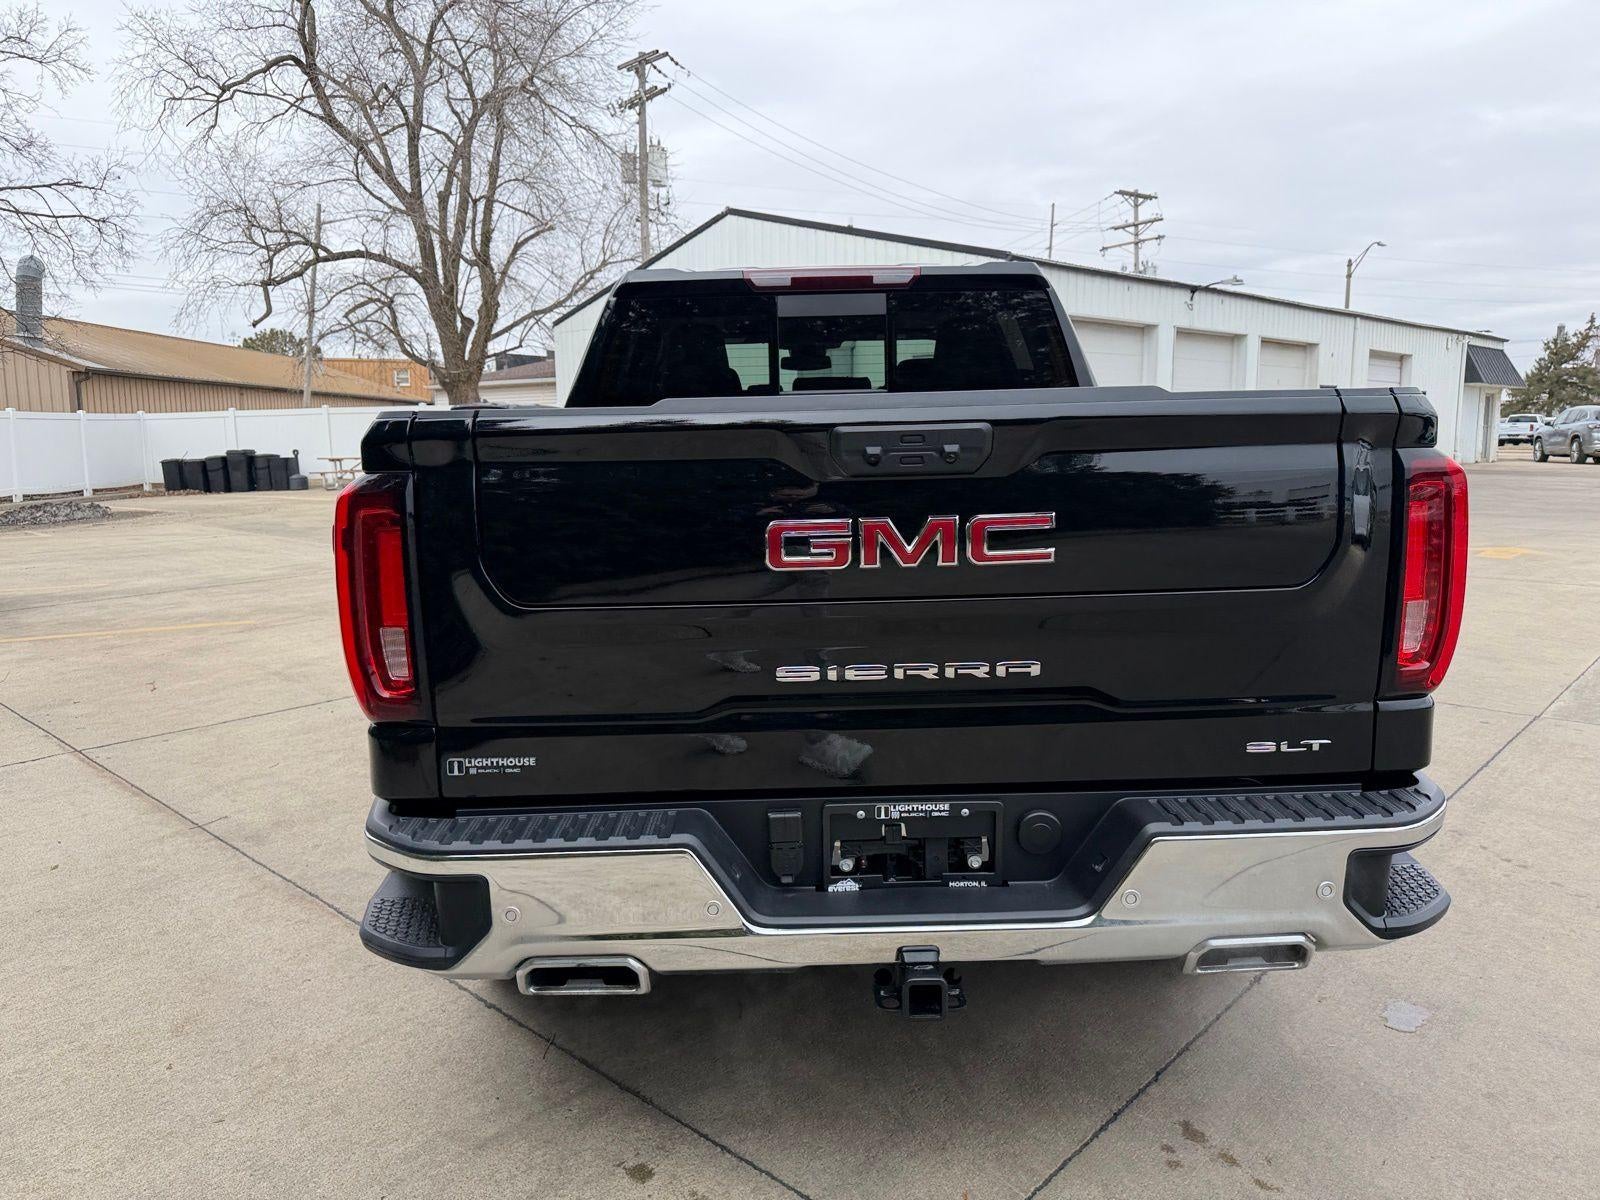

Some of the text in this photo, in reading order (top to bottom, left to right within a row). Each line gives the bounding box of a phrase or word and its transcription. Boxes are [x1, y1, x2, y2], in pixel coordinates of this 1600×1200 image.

[765, 511, 1056, 571] GMC
[775, 660, 1041, 683] SIERRA
[1245, 739, 1332, 753] SLT
[465, 756, 536, 767] LIGHTHOUSE
[890, 803, 950, 812] LIGHTHOUSE
